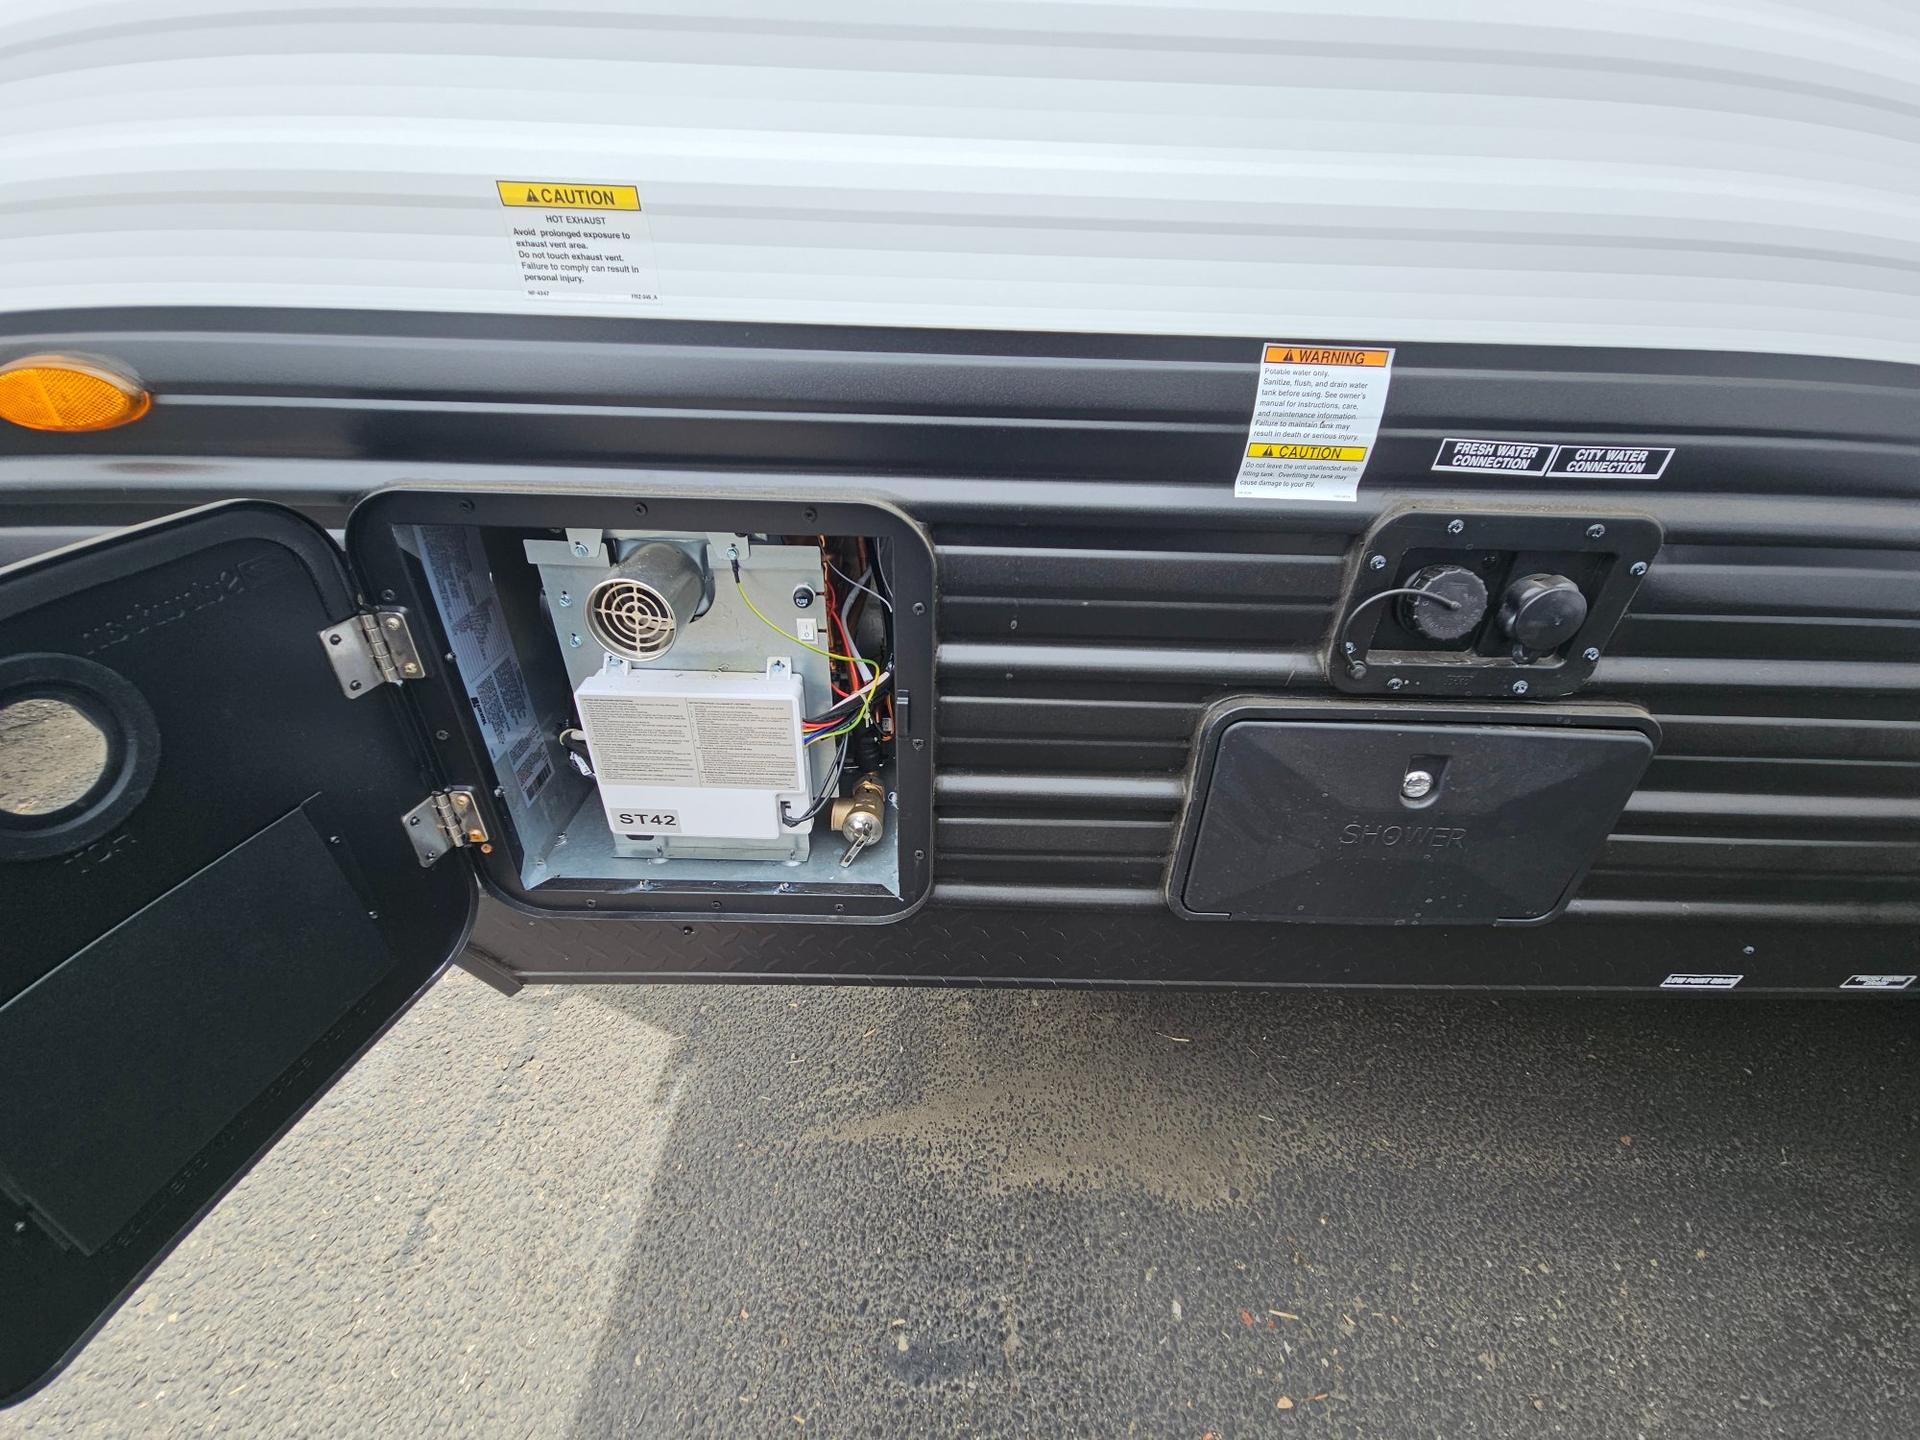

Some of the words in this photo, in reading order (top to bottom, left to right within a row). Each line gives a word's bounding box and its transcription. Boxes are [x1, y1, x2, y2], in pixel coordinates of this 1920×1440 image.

[541, 188, 615, 206] CAUTION
[545, 215, 563, 224] HOT
[566, 215, 606, 225] EXHAUST
[513, 228, 536, 236] Avoid
[540, 229, 581, 239] prolonged
[583, 230, 620, 240] exposure
[622, 231, 631, 239] to
[516, 240, 548, 249] exhaust
[550, 241, 567, 249] vent
[569, 242, 589, 250] area.
[518, 251, 530, 259] Do
[532, 252, 545, 260] not
[547, 251, 570, 260] touch
[571, 253, 603, 261] exhaust
[605, 254, 624, 262] vent.
[522, 262, 549, 270] Failure
[550, 263, 559, 271] to
[560, 264, 589, 274] comply
[591, 265, 605, 273] can
[607, 265, 630, 273] result
[631, 265, 640, 274] in
[524, 273, 558, 283] personal
[560, 274, 585, 284] injury.
[1300, 350, 1365, 365] WARNING
[1264, 368, 1290, 376] Potable
[1292, 369, 1311, 377] water
[1312, 369, 1330, 378] only.
[1263, 378, 1292, 387] Sanitize,
[1315, 380, 1328, 388] and
[1261, 389, 1277, 397] tank
[1279, 389, 1300, 397] before
[1301, 391, 1323, 400] using.
[1325, 391, 1338, 399] See
[1339, 392, 1366, 400] owner's
[1259, 400, 1285, 408] manual
[1286, 400, 1297, 408] for
[1297, 401, 1340, 409] instructions,
[1272, 411, 1315, 419] maintenance
[1317, 412, 1357, 420] information.
[1255, 419, 1278, 427] Failure
[1288, 420, 1317, 428] maintain
[1319, 420, 1334, 429] tank
[1284, 431, 1301, 439] death
[1312, 432, 1336, 440] serious
[1279, 446, 1342, 459] CAUTION
[1453, 442, 1496, 456] FRESH
[1497, 445, 1539, 458] WATER
[1574, 449, 1606, 461] CITY
[1606, 450, 1649, 462] WATER
[1307, 464, 1341, 472] unattended
[1452, 455, 1531, 470] CONNECTION
[1566, 461, 1646, 473] CONNECTION
[1258, 480, 1282, 488] damage
[620, 814, 676, 826] ST42
[1339, 824, 1467, 848] SHOWER
